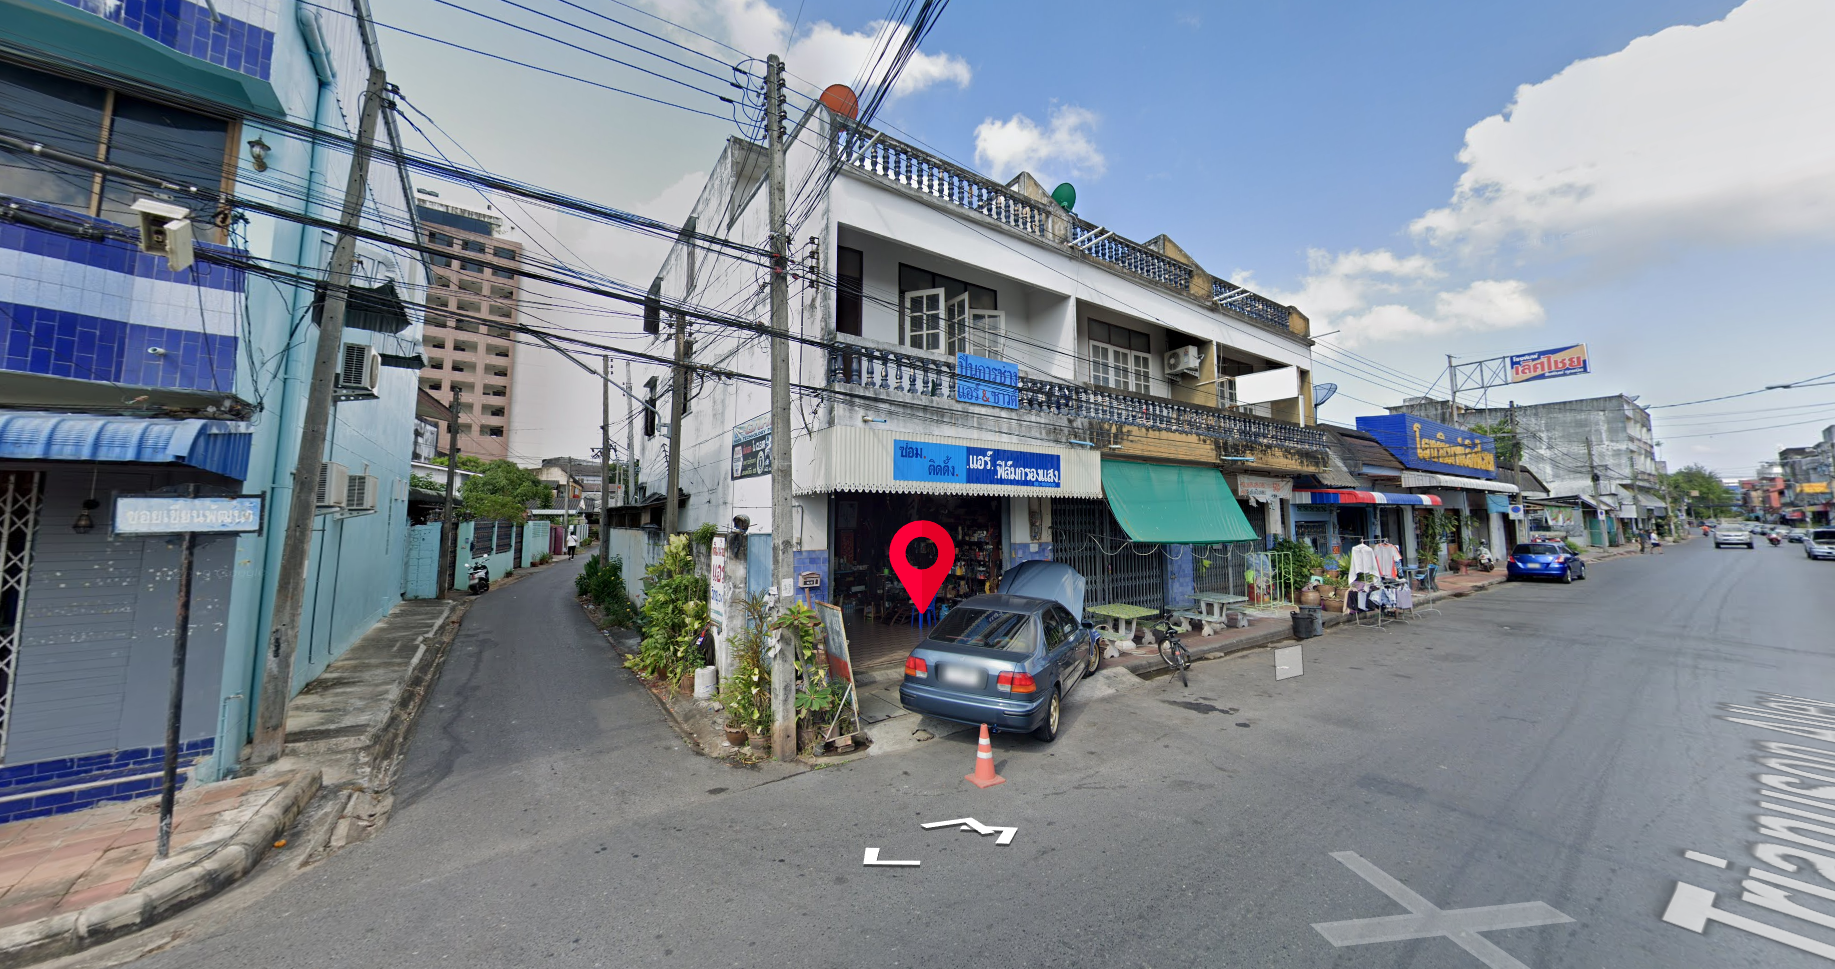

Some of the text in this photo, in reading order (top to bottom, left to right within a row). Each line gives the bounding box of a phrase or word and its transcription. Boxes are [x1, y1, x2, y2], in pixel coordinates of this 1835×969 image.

[1514, 355, 1583, 376] เลิศไชย
[958, 383, 980, 401] แอร์
[982, 389, 990, 403] &
